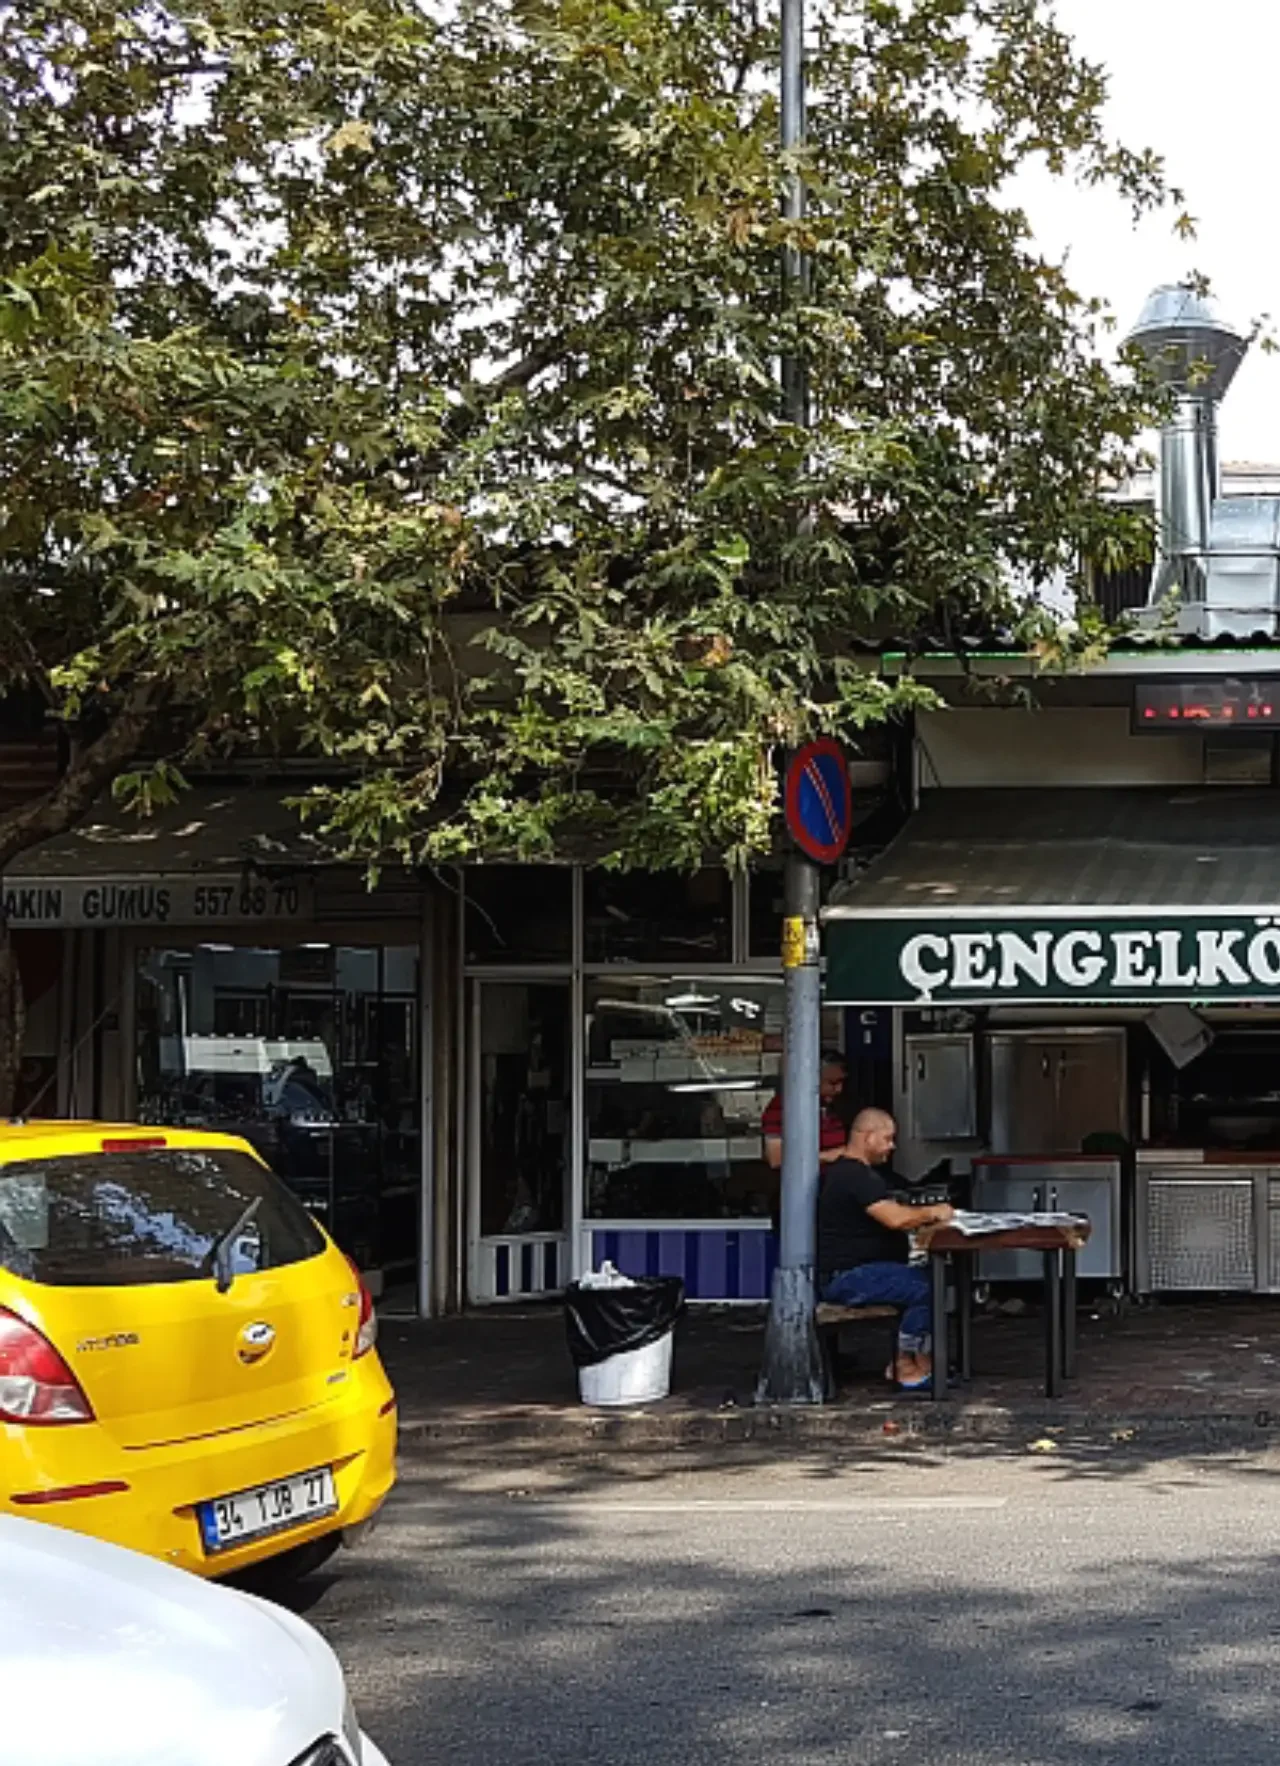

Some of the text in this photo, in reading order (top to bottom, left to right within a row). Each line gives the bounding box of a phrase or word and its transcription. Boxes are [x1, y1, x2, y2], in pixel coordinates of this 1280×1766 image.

[194, 886, 234, 917] 557
[273, 885, 299, 917] 70
[216, 1473, 323, 1535] 34 TJB 27
